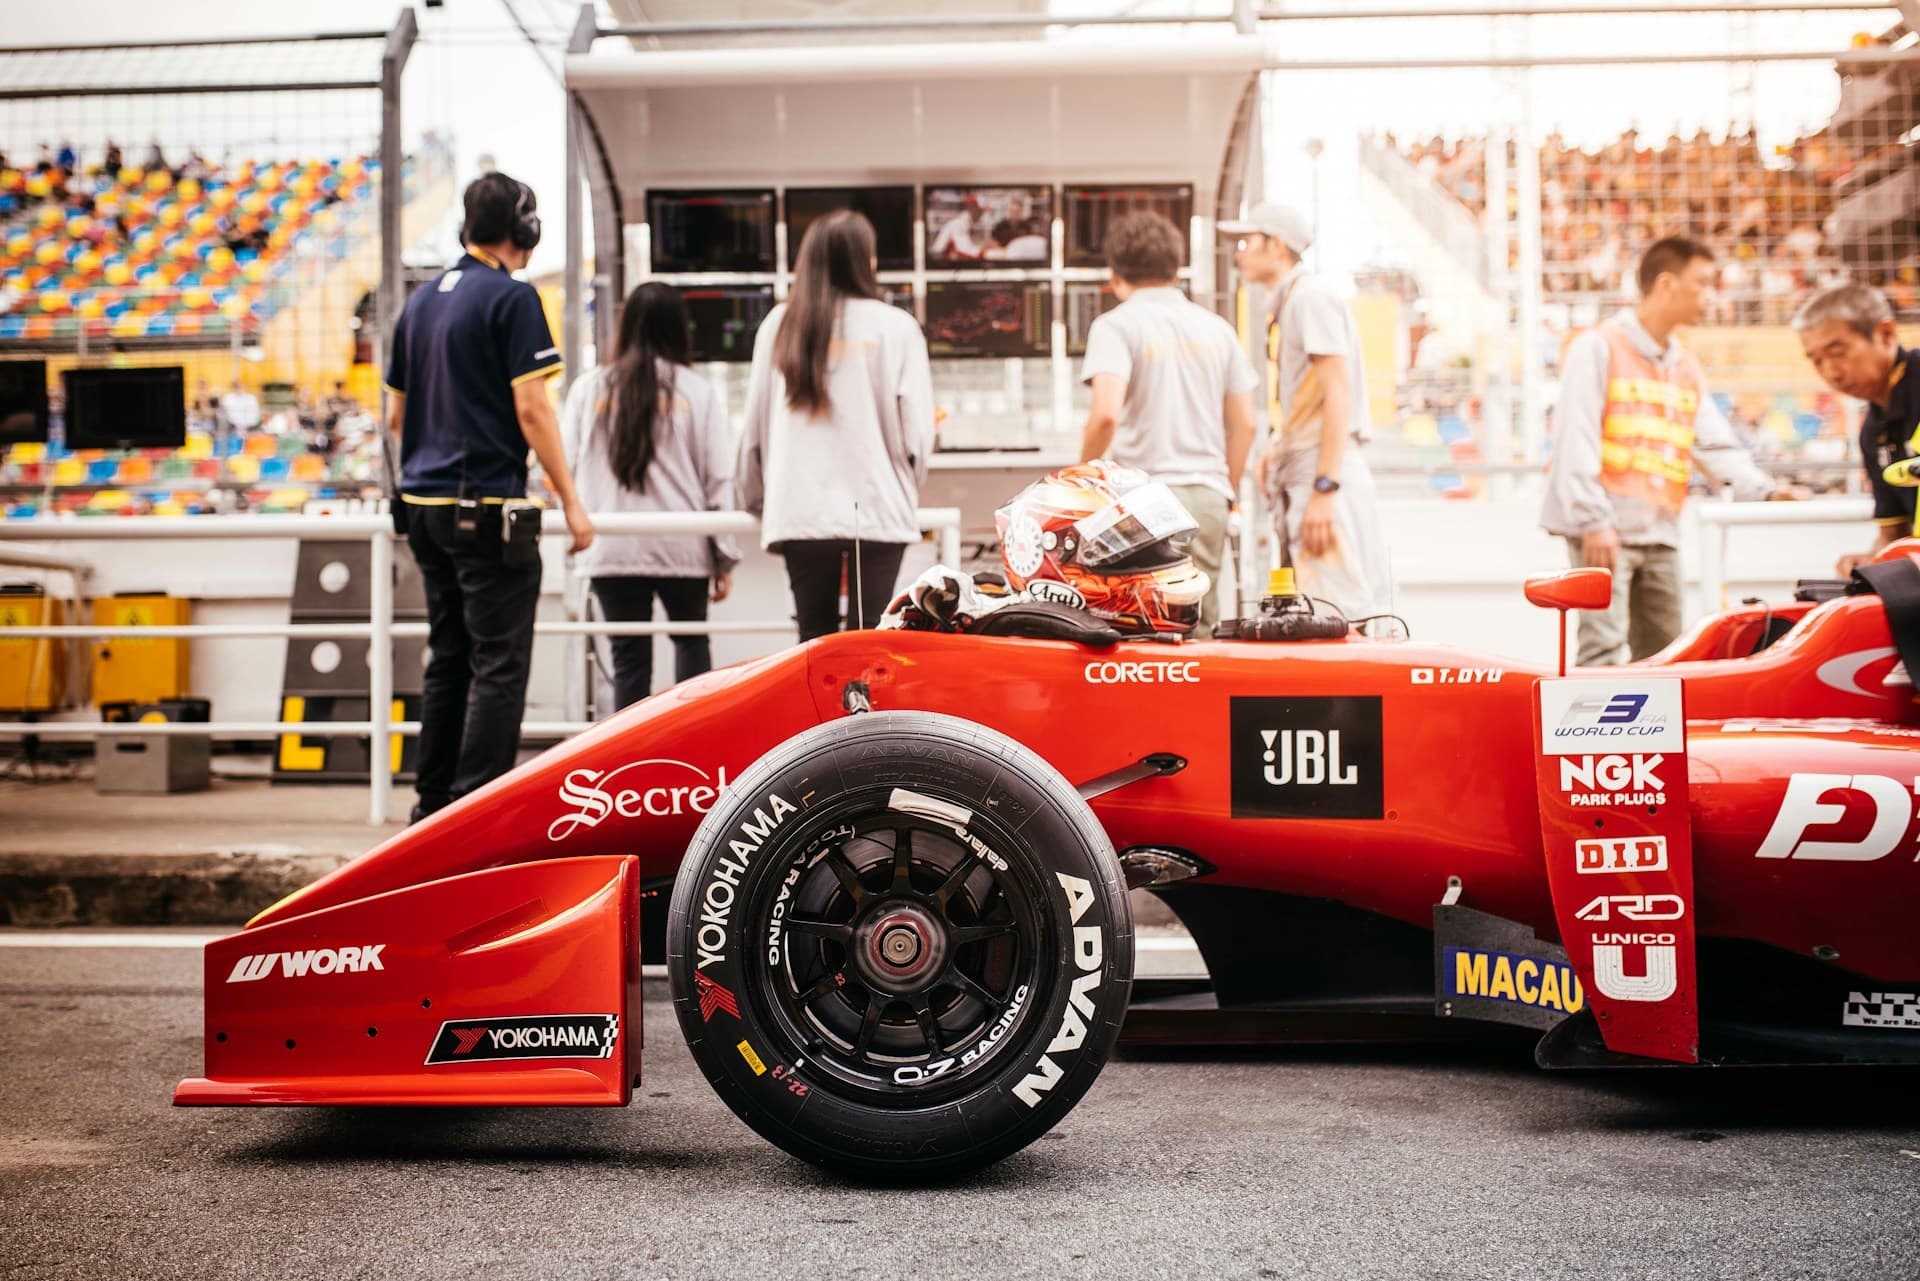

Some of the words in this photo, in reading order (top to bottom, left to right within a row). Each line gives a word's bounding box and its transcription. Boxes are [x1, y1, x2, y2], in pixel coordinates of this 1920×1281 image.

[1030, 585, 1076, 606] Arai
[1084, 661, 1200, 684] CORETEC
[1557, 693, 1650, 726] F3
[1554, 726, 1624, 737] WORLD
[1627, 726, 1665, 737] CUP
[860, 744, 976, 769] ADVAN
[1260, 729, 1358, 785] JBL
[1559, 753, 1665, 792] NGK
[1570, 793, 1612, 807] PARK
[1614, 792, 1667, 806] PLUGS
[1580, 841, 1660, 869] D.I.D
[696, 793, 798, 970] YOKOHAMA
[768, 867, 801, 967] RACING
[1574, 894, 1685, 921] ARD
[1591, 933, 1676, 945] UNICO
[281, 944, 387, 978] WORK
[1011, 871, 1103, 1109] ADVAN
[1455, 951, 1584, 1015] MACAU
[488, 1026, 600, 1050] YOKOHAMA
[959, 984, 1029, 1069] RACING
